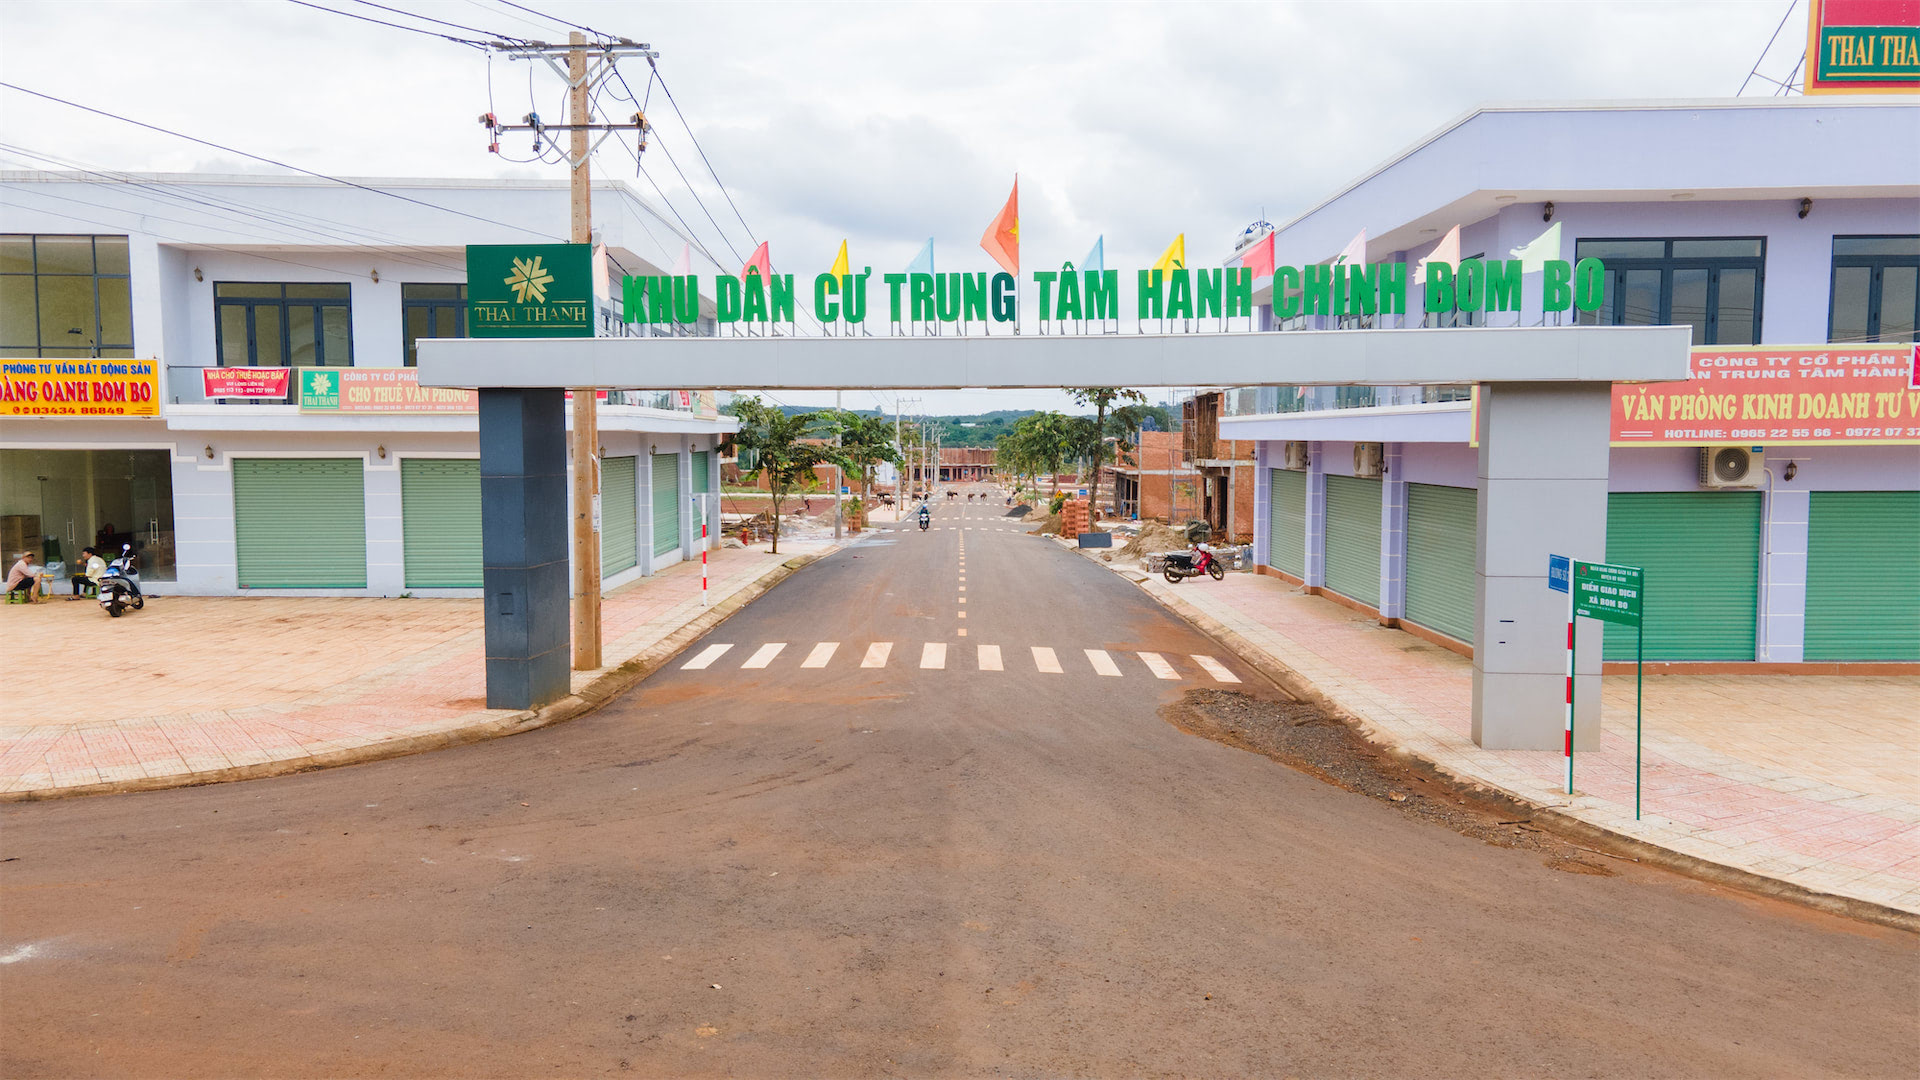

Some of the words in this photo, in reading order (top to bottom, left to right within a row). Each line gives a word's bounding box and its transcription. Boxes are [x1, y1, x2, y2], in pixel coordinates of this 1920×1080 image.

[1828, 35, 1876, 66] THAI
[622, 274, 699, 324] KHU
[716, 265, 795, 323] DÂN
[814, 266, 872, 324] CƯ
[884, 272, 1016, 322] TRUNG
[1034, 261, 1118, 320] TÂM
[1138, 259, 1252, 319] HÀNH
[1272, 255, 1407, 318] CHÍNH
[1426, 258, 1523, 313] BOM
[1543, 257, 1605, 312] BO
[474, 307, 516, 321] THAI
[523, 306, 587, 321] THANH
[3, 362, 36, 375] PHÒNG
[39, 363, 51, 375] TƯ
[55, 360, 76, 375] VẤN
[78, 360, 98, 375] BẤT
[101, 364, 128, 377] ĐỘNG
[130, 362, 151, 375] SẢN
[1699, 356, 1758, 367] CÔNG
[1765, 357, 1792, 366] TY
[343, 371, 368, 381] CÔNG
[370, 373, 381, 381] TY
[1718, 369, 1791, 379] TRUNG
[1798, 367, 1845, 378] TÂM
[0, 375, 39, 402] ÀNG
[42, 381, 90, 402] OANH
[92, 381, 128, 402] BOM
[130, 381, 153, 402] BO
[348, 387, 371, 402] CHO
[374, 383, 403, 402] THUÊ
[32, 407, 76, 415] 03434
[81, 407, 124, 415] 86849
[1621, 387, 1665, 420] VĂN
[1669, 387, 1737, 420] PHÒNG
[1742, 394, 1794, 420] KINH
[1797, 393, 1870, 419] DOANH
[1875, 387, 1905, 418] TƯ
[1664, 429, 1727, 438] HOTLINE:
[1770, 429, 1788, 437] 22
[1792, 429, 1809, 437] 55
[1813, 428, 1832, 437] 66
[1846, 428, 1881, 437] 0972
[1885, 428, 1903, 436] 07
[1600, 598, 1616, 607] BOM
[1617, 601, 1628, 609] BO
